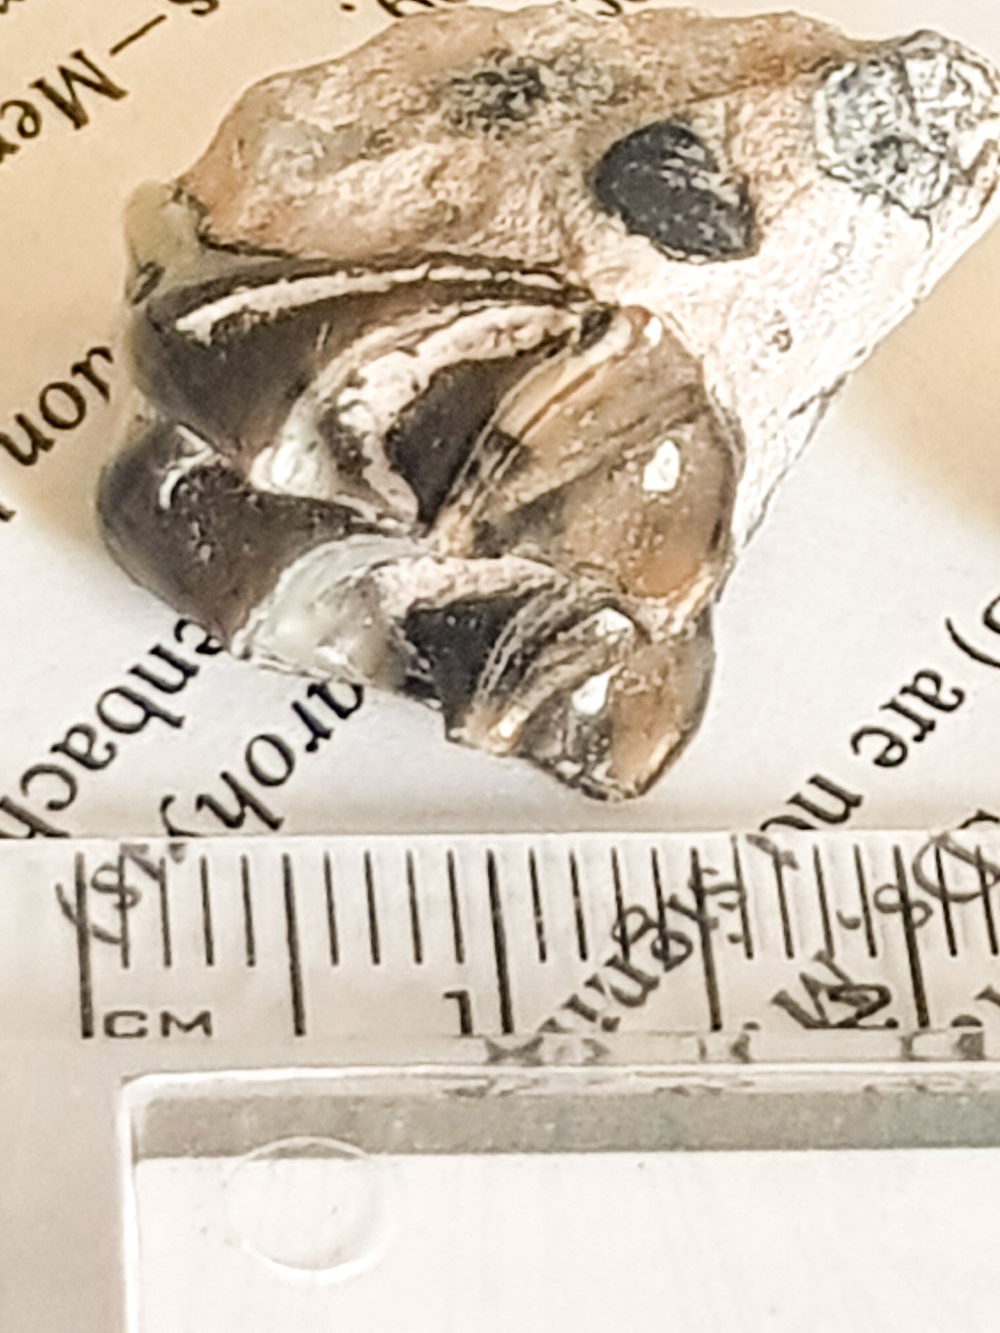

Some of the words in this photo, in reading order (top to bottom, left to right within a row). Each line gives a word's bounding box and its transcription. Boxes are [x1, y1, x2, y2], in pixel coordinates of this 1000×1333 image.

[849, 667, 967, 771] are
[102, 1009, 213, 1040] CM
[442, 988, 475, 1036] 1
